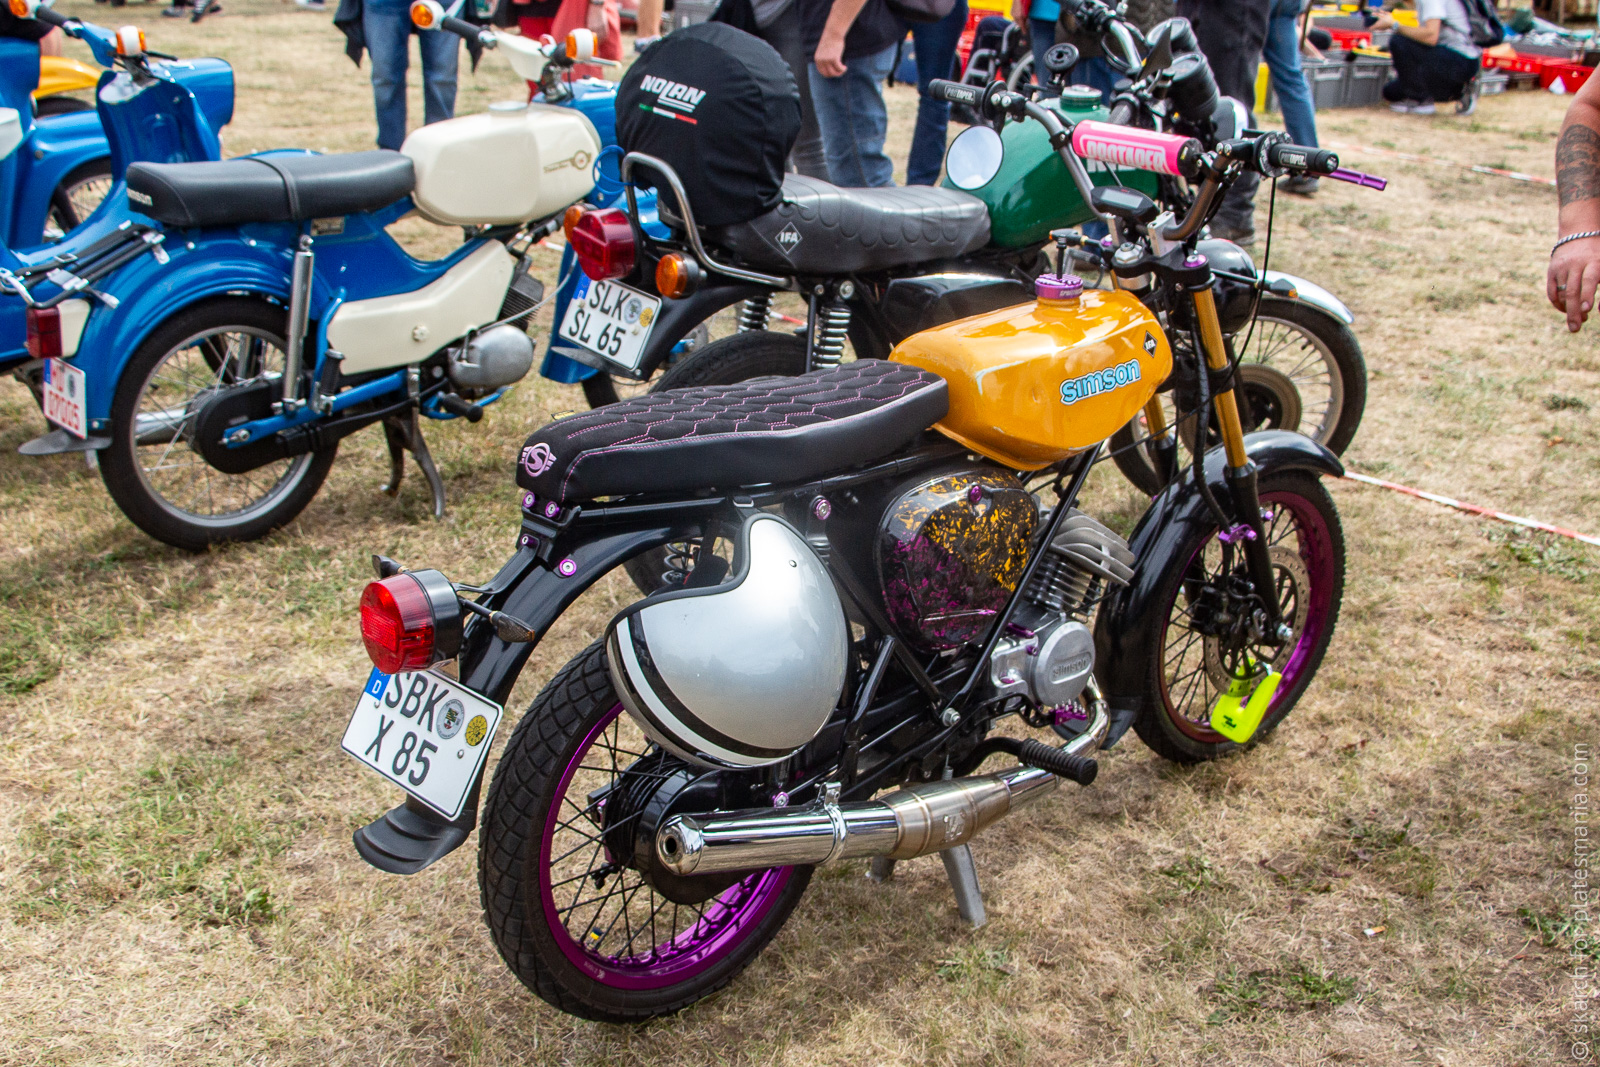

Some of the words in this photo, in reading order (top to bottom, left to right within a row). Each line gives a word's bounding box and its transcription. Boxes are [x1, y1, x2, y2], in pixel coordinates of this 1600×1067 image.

[640, 74, 707, 109] NOLAN
[780, 231, 798, 243] IFA
[589, 281, 631, 321] SLK
[568, 308, 591, 343] SL
[597, 322, 626, 356] 65
[1144, 339, 1156, 351] IFA
[1061, 359, 1141, 405] simson
[371, 679, 383, 695] D
[384, 672, 450, 732] SBK
[364, 714, 395, 762] X
[391, 731, 439, 786] 85
